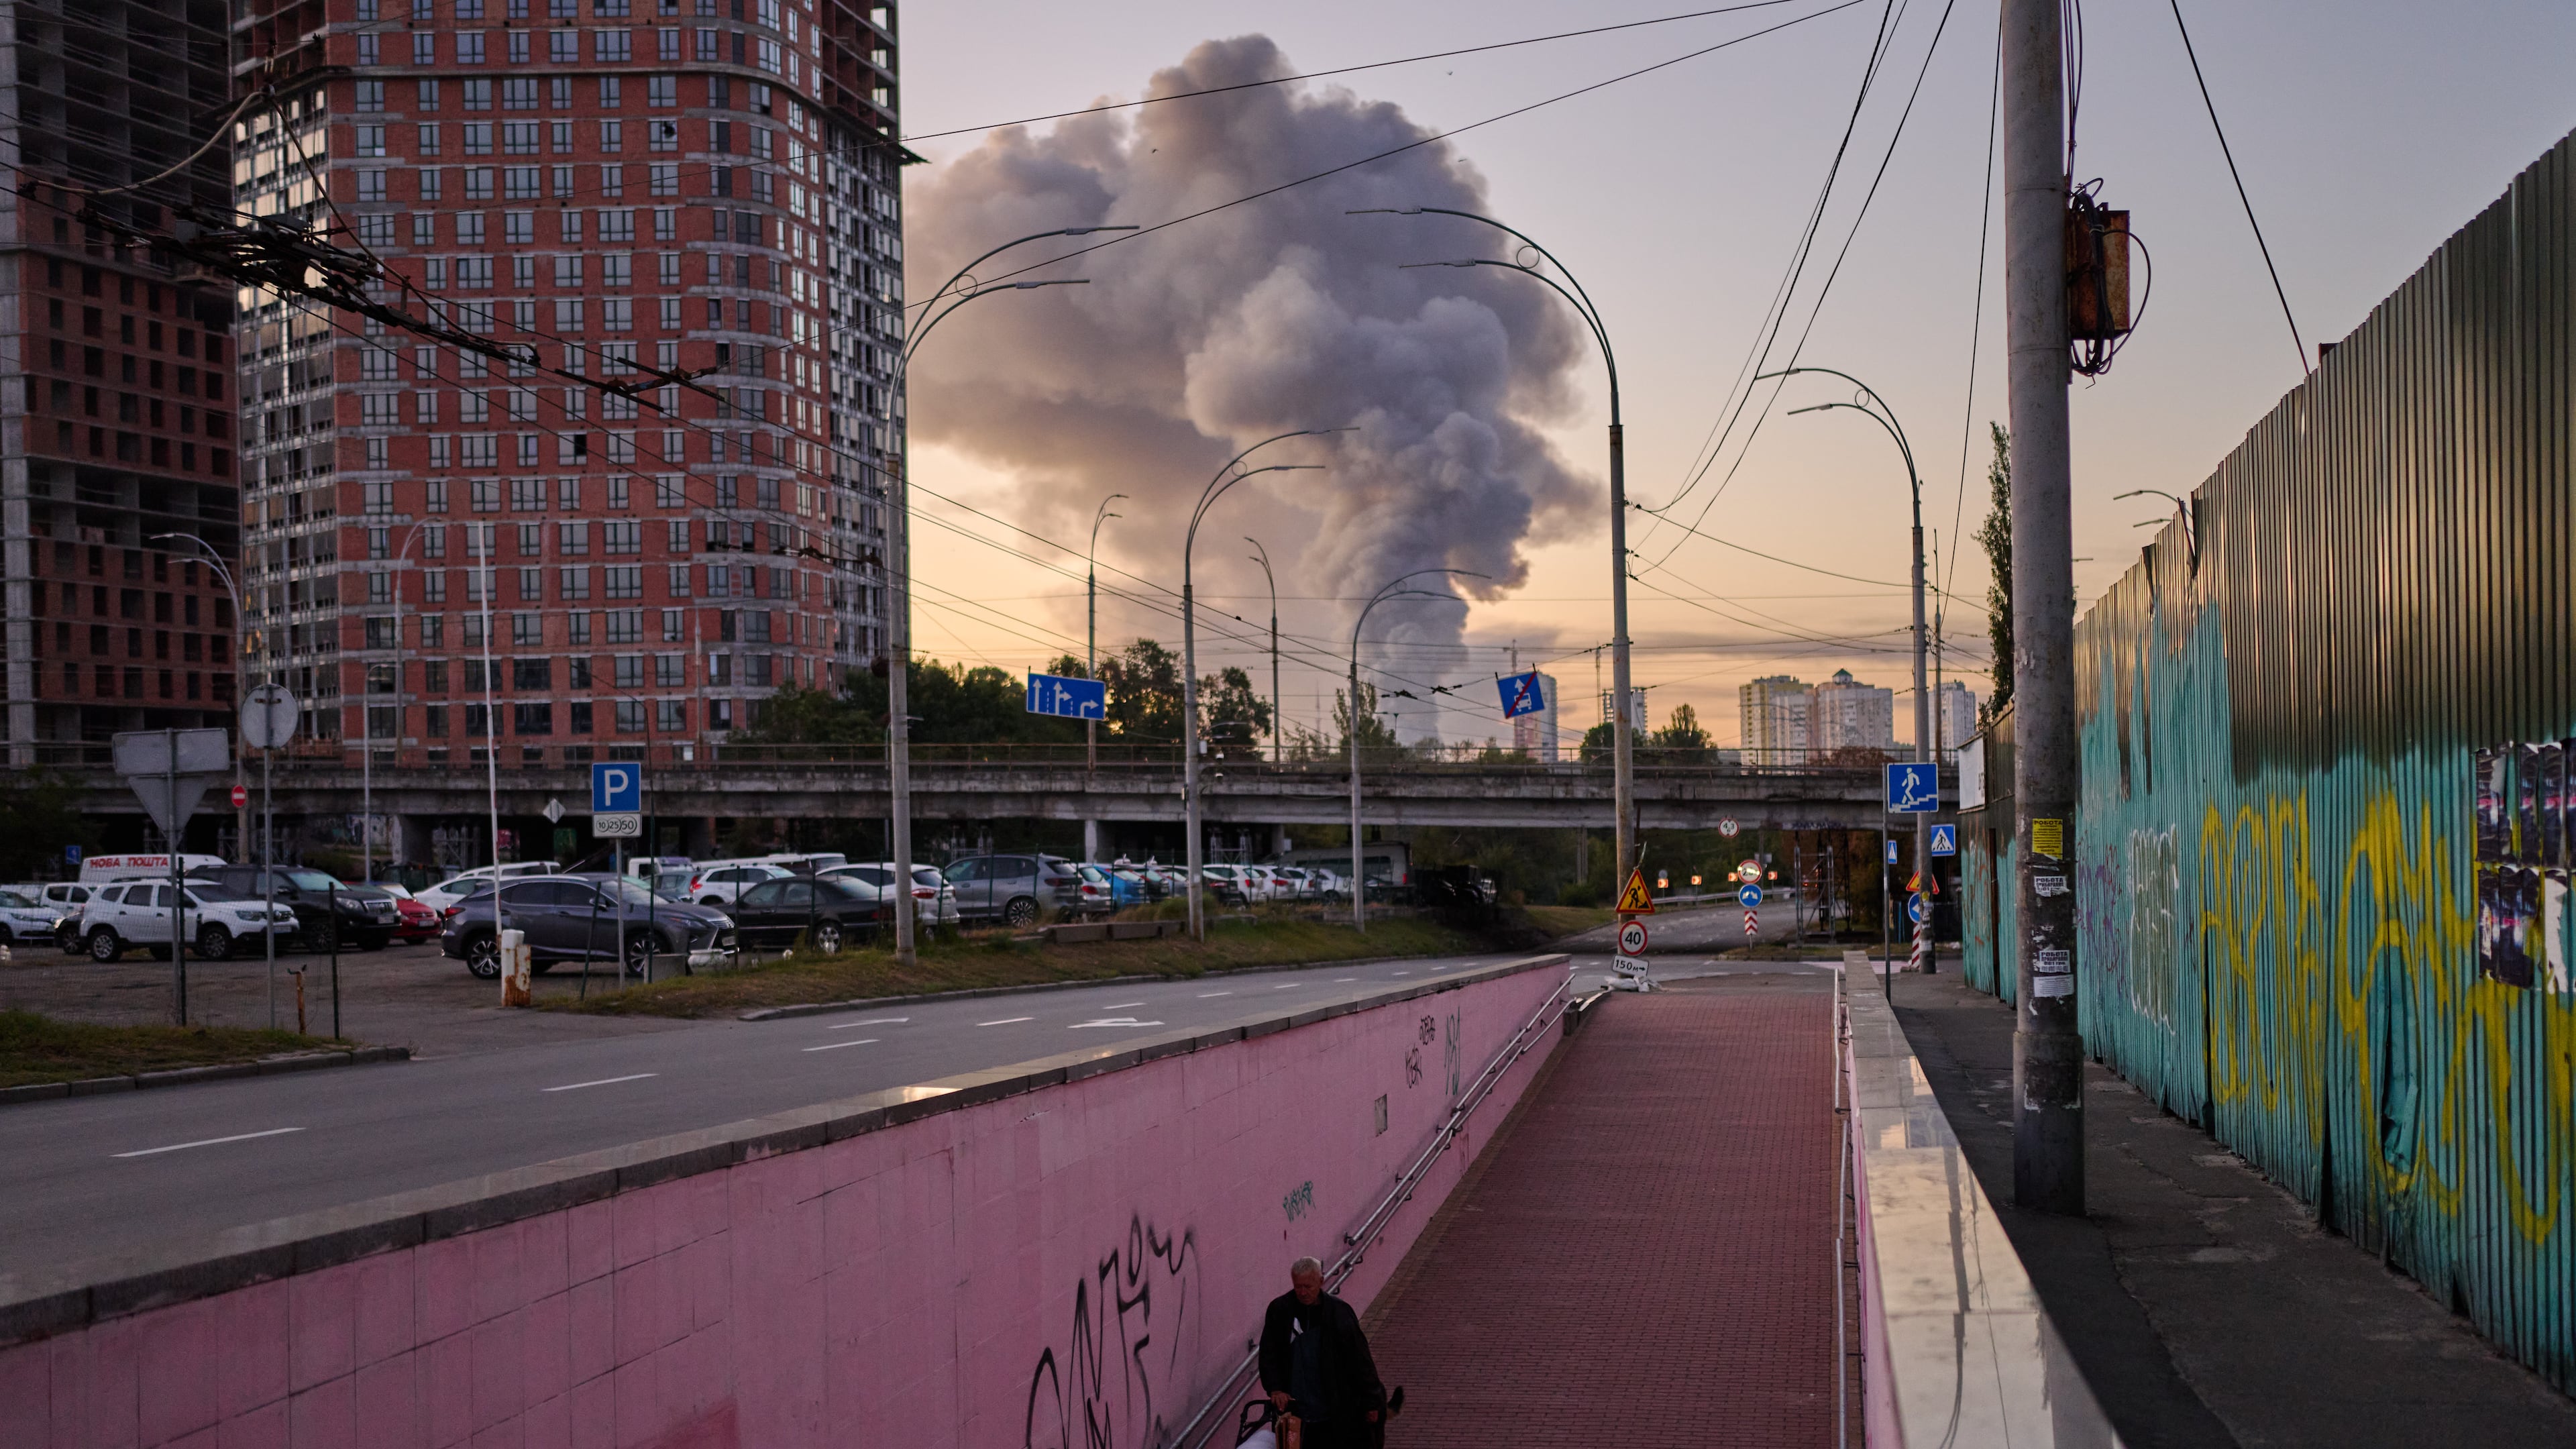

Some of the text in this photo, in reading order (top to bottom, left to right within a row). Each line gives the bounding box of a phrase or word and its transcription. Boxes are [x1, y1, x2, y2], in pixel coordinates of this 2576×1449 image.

[604, 769, 629, 807] P
[598, 820, 634, 830] 10 25 50
[90, 857, 168, 868] НОВА ПОШТА
[1625, 931, 1642, 945] 40
